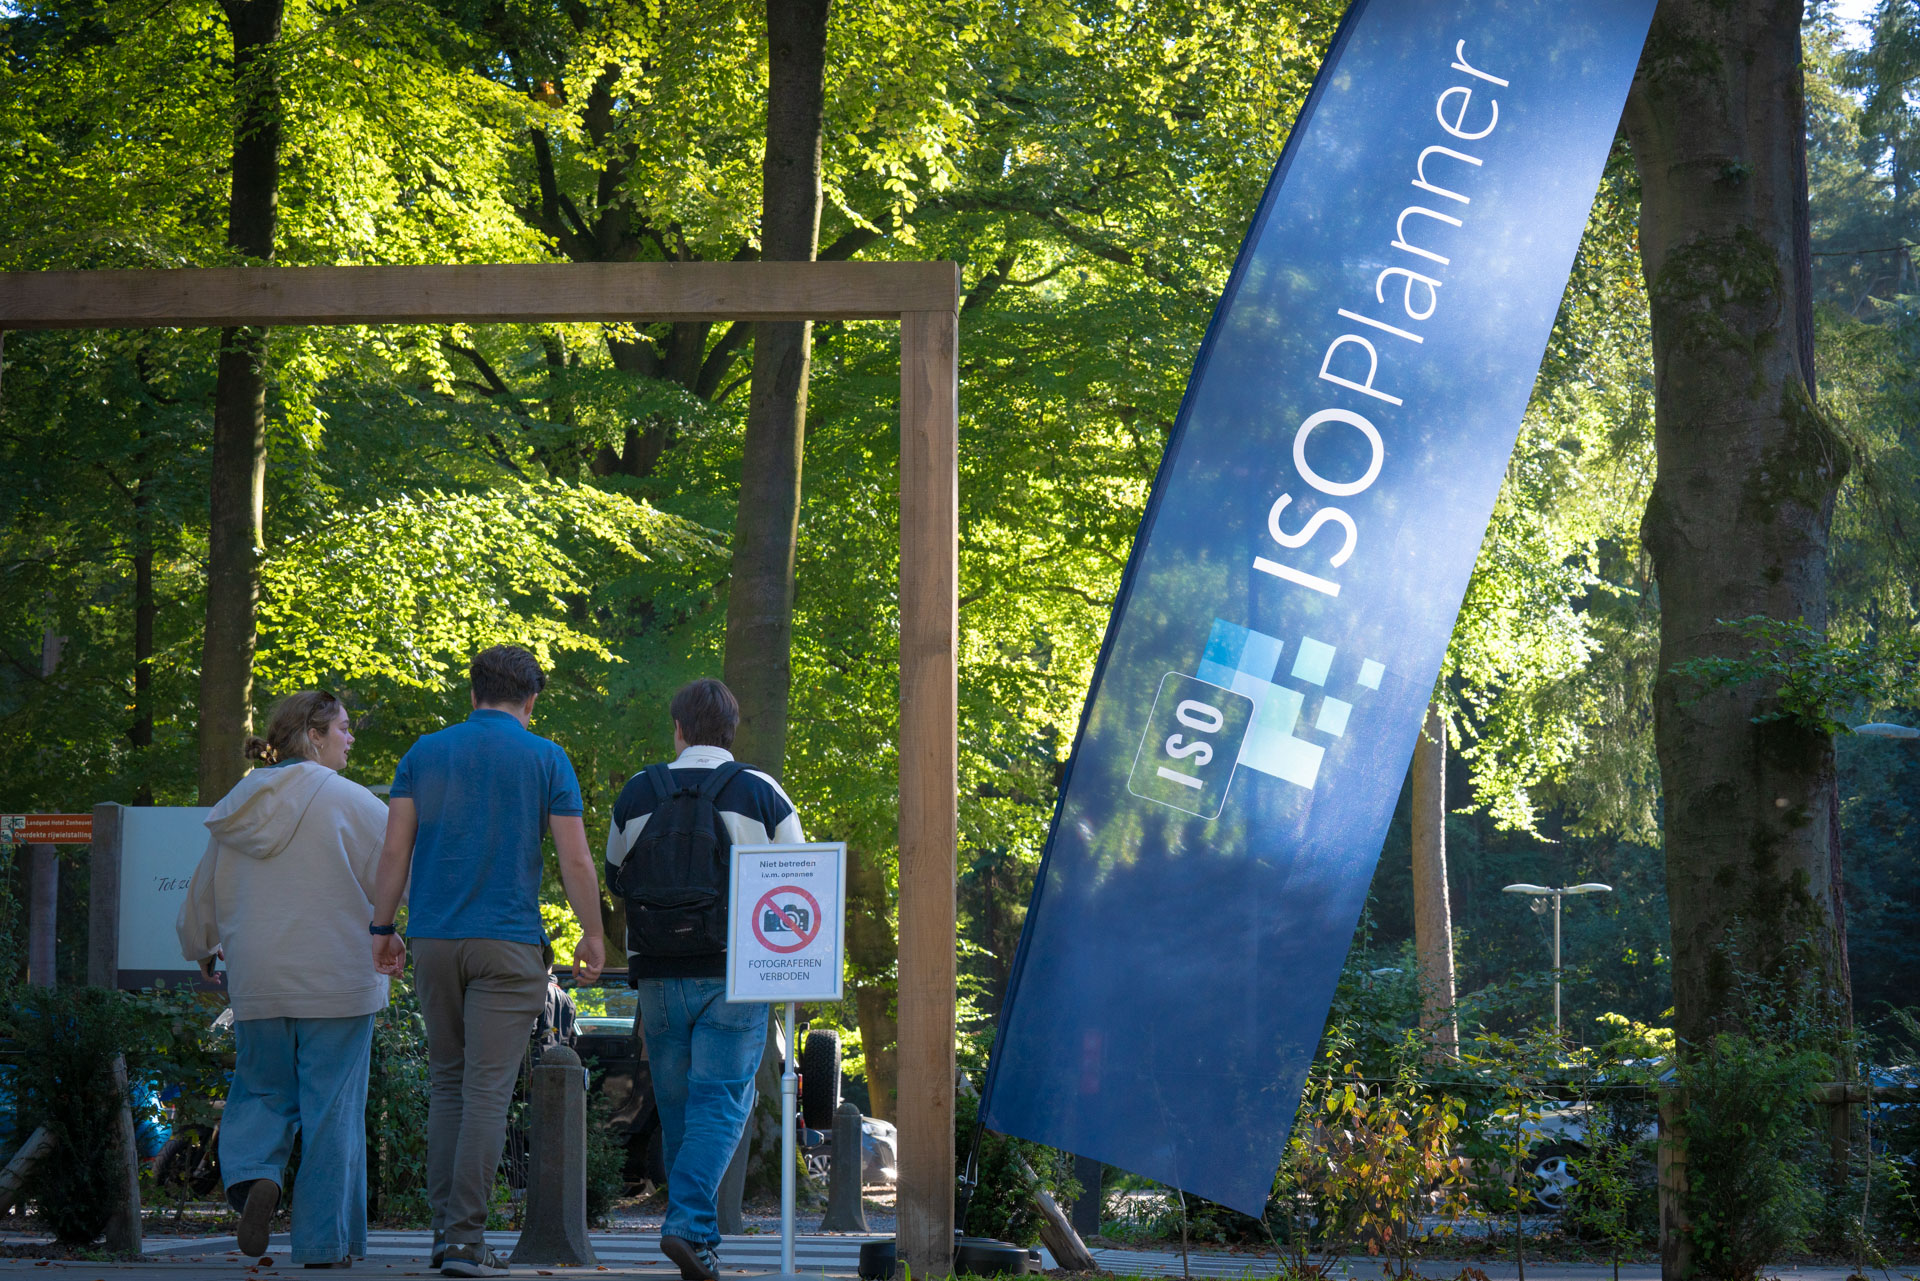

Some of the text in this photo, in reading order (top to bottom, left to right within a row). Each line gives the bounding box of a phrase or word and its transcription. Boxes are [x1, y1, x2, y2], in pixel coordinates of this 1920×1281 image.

[1251, 38, 1510, 597] ISOPlanner
[1156, 699, 1224, 790] ISO
[26, 819, 50, 827] Landgoed
[14, 831, 92, 840] Overdekte rijwielstalling
[759, 859, 816, 868] Niet betreden
[781, 871, 814, 879] opnames
[178, 876, 192, 890] zi
[748, 958, 822, 969] FOTOGRAFEREN
[759, 971, 810, 981] VERBODEN
